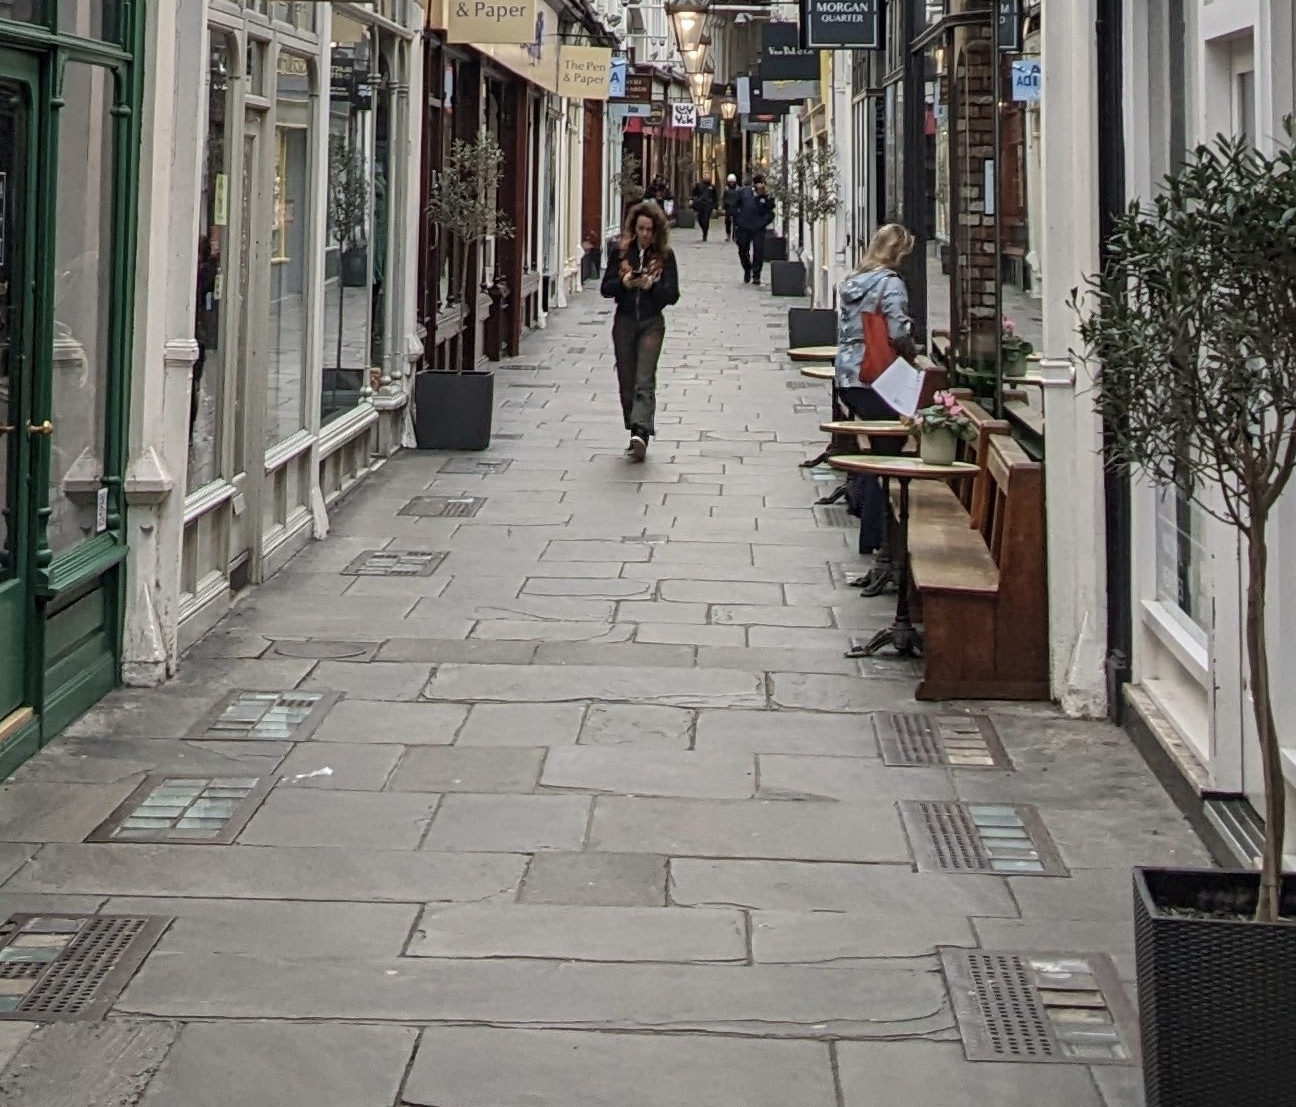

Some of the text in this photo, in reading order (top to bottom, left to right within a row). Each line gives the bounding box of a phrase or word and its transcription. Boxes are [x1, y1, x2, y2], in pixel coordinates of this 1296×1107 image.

[455, 2, 528, 22] & Paper
[816, 1, 869, 12] MORGAN
[820, 14, 864, 23] QUARTER
[564, 60, 606, 72] The Pen
[563, 73, 571, 82] &
[573, 73, 605, 86] Paper
